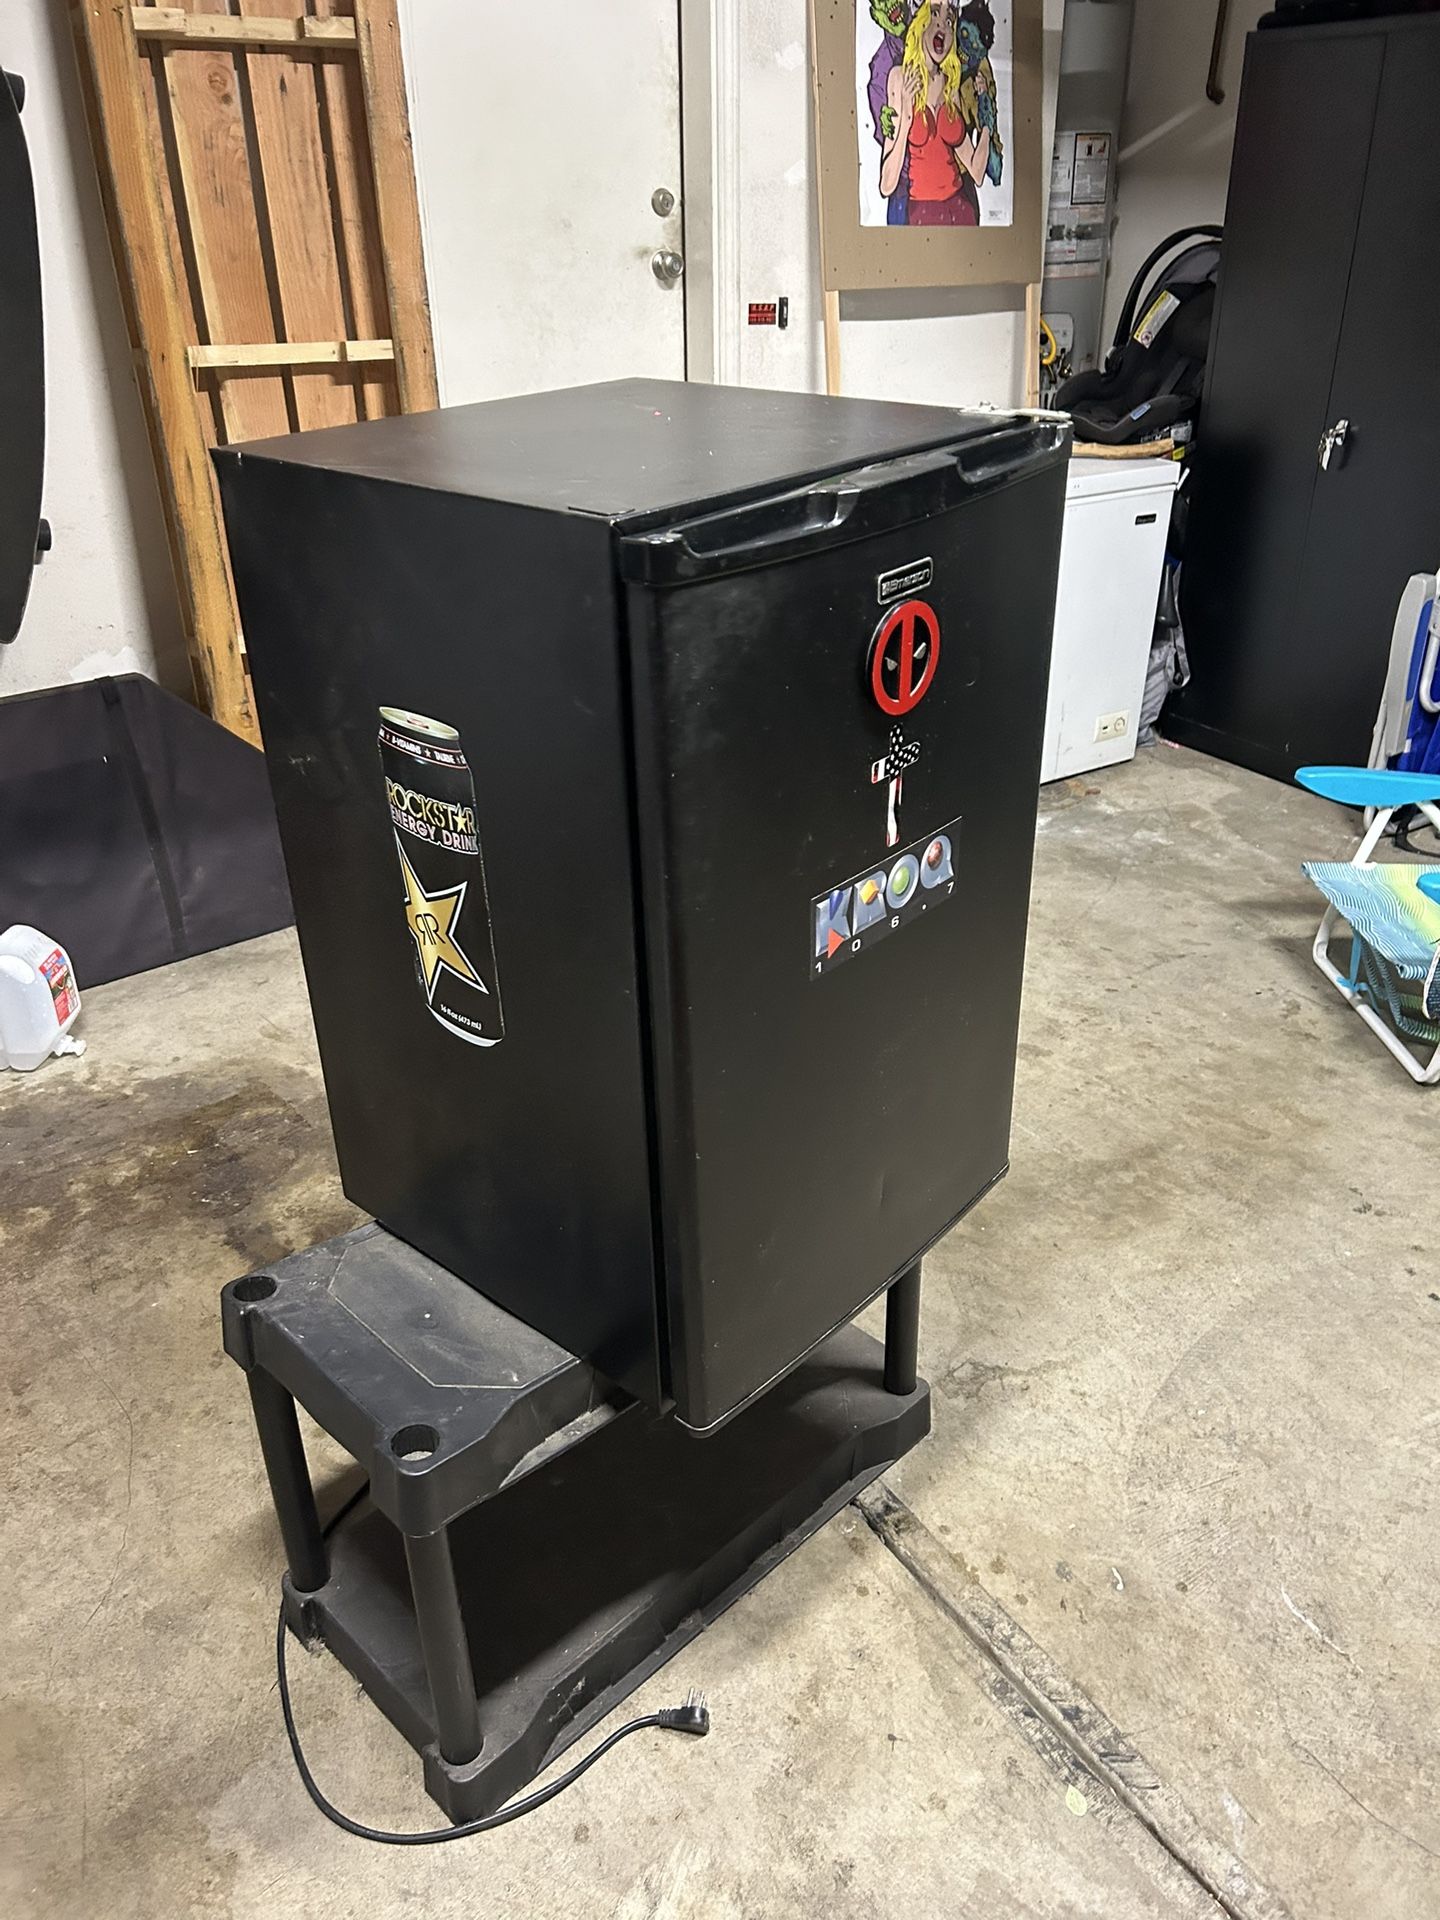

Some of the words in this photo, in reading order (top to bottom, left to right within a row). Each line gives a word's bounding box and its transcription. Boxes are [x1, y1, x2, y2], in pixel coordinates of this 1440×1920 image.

[390, 804, 436, 840] ENERGY
[442, 829, 478, 851] DRINK
[815, 835, 954, 957] KROQ
